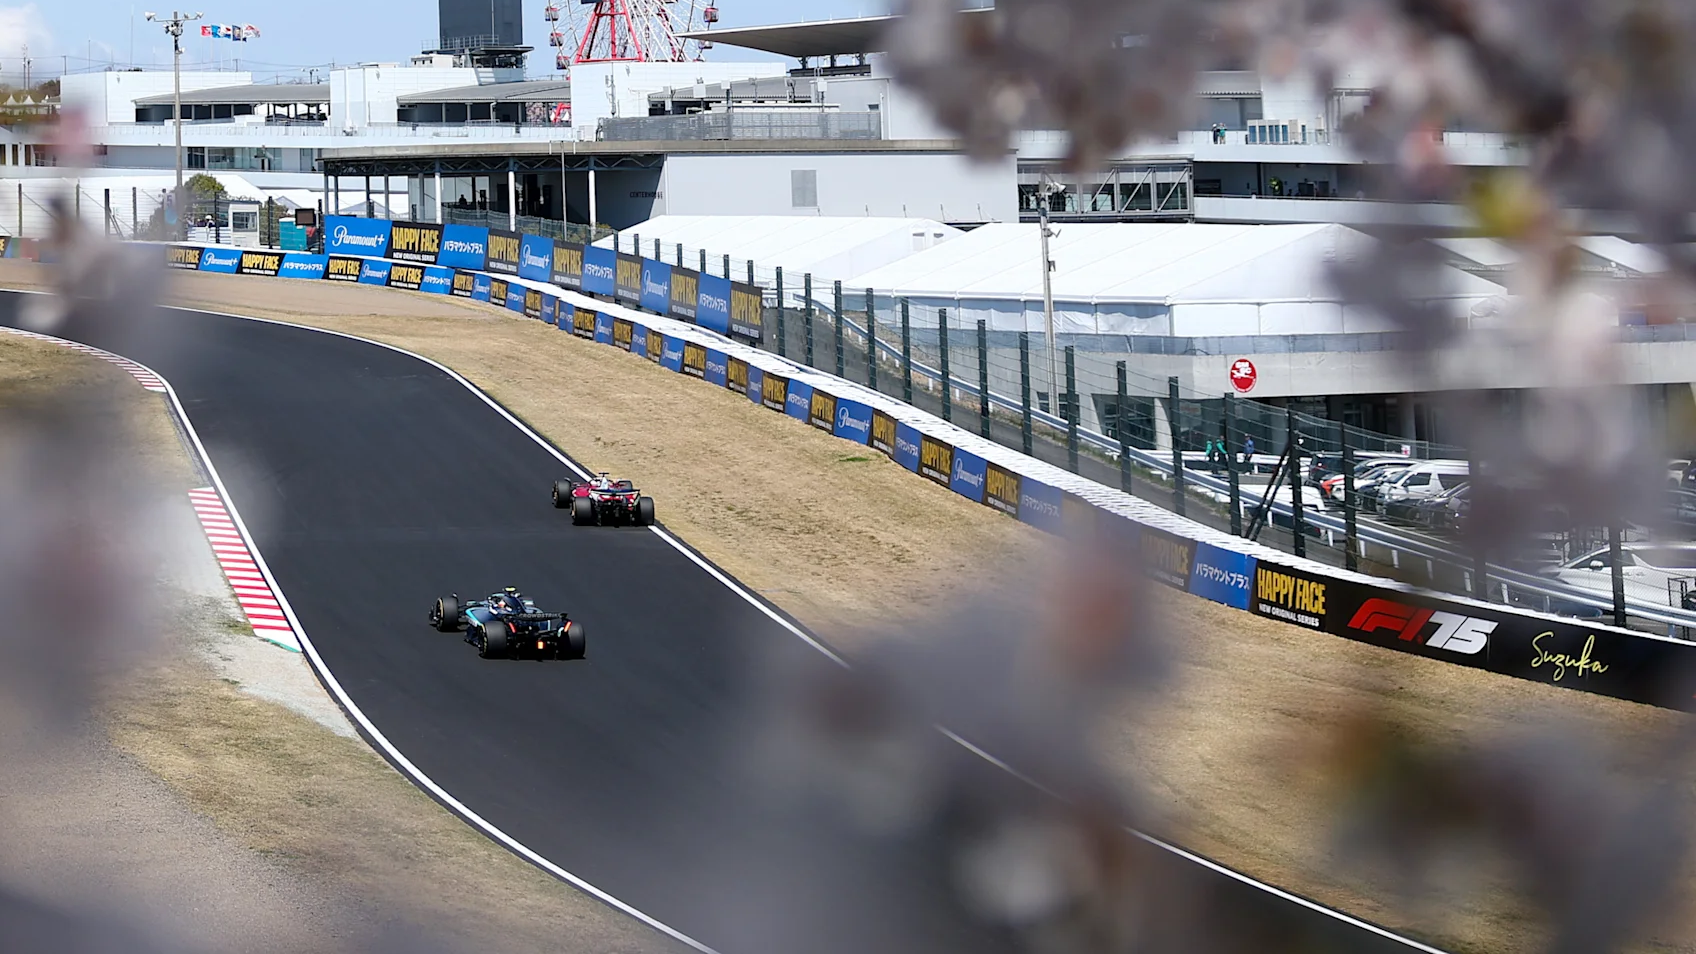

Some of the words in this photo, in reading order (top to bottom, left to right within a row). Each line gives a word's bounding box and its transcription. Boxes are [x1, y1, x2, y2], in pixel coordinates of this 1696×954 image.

[332, 225, 384, 248] Paramount+
[392, 226, 420, 252] HAPPY
[421, 229, 440, 253] FACE
[444, 241, 484, 254] パラマウントプラス
[488, 234, 506, 261] HAPPY
[506, 238, 519, 263] FACE
[186, 250, 199, 263] FACE
[203, 252, 238, 266] Paramount+
[242, 254, 263, 269] HAPPY
[263, 255, 279, 270] FACE
[329, 258, 347, 274] HAPPY
[347, 260, 360, 275] FACE
[522, 244, 550, 268] Paramount+
[554, 246, 570, 274] HAPPY
[570, 250, 582, 276] FACE
[362, 264, 387, 278] Paramount+
[390, 266, 408, 282] HAPPY
[408, 268, 422, 283] FACE
[616, 258, 631, 288] HAPPY
[631, 262, 641, 290] FACE
[644, 270, 668, 297] Paramount+
[670, 272, 686, 305] HAPPY
[686, 277, 696, 306] FACE
[731, 289, 747, 323] HAPPY
[748, 293, 761, 326] FACE
[838, 407, 869, 432] Paramount+
[922, 438, 940, 470] HAPPY
[940, 446, 951, 474] FACE
[954, 458, 983, 487] Paramount+
[987, 466, 1004, 498] HAPPY
[1004, 472, 1017, 504] FACE
[1196, 563, 1250, 590] パラマウントプラス
[1257, 567, 1296, 610] HAPPY
[1296, 578, 1326, 615] FACE
[1258, 602, 1271, 613] NEW
[1272, 606, 1296, 622] ORIGINAL
[1297, 612, 1320, 627] SERIES
[1531, 631, 1609, 681] Suzuka
